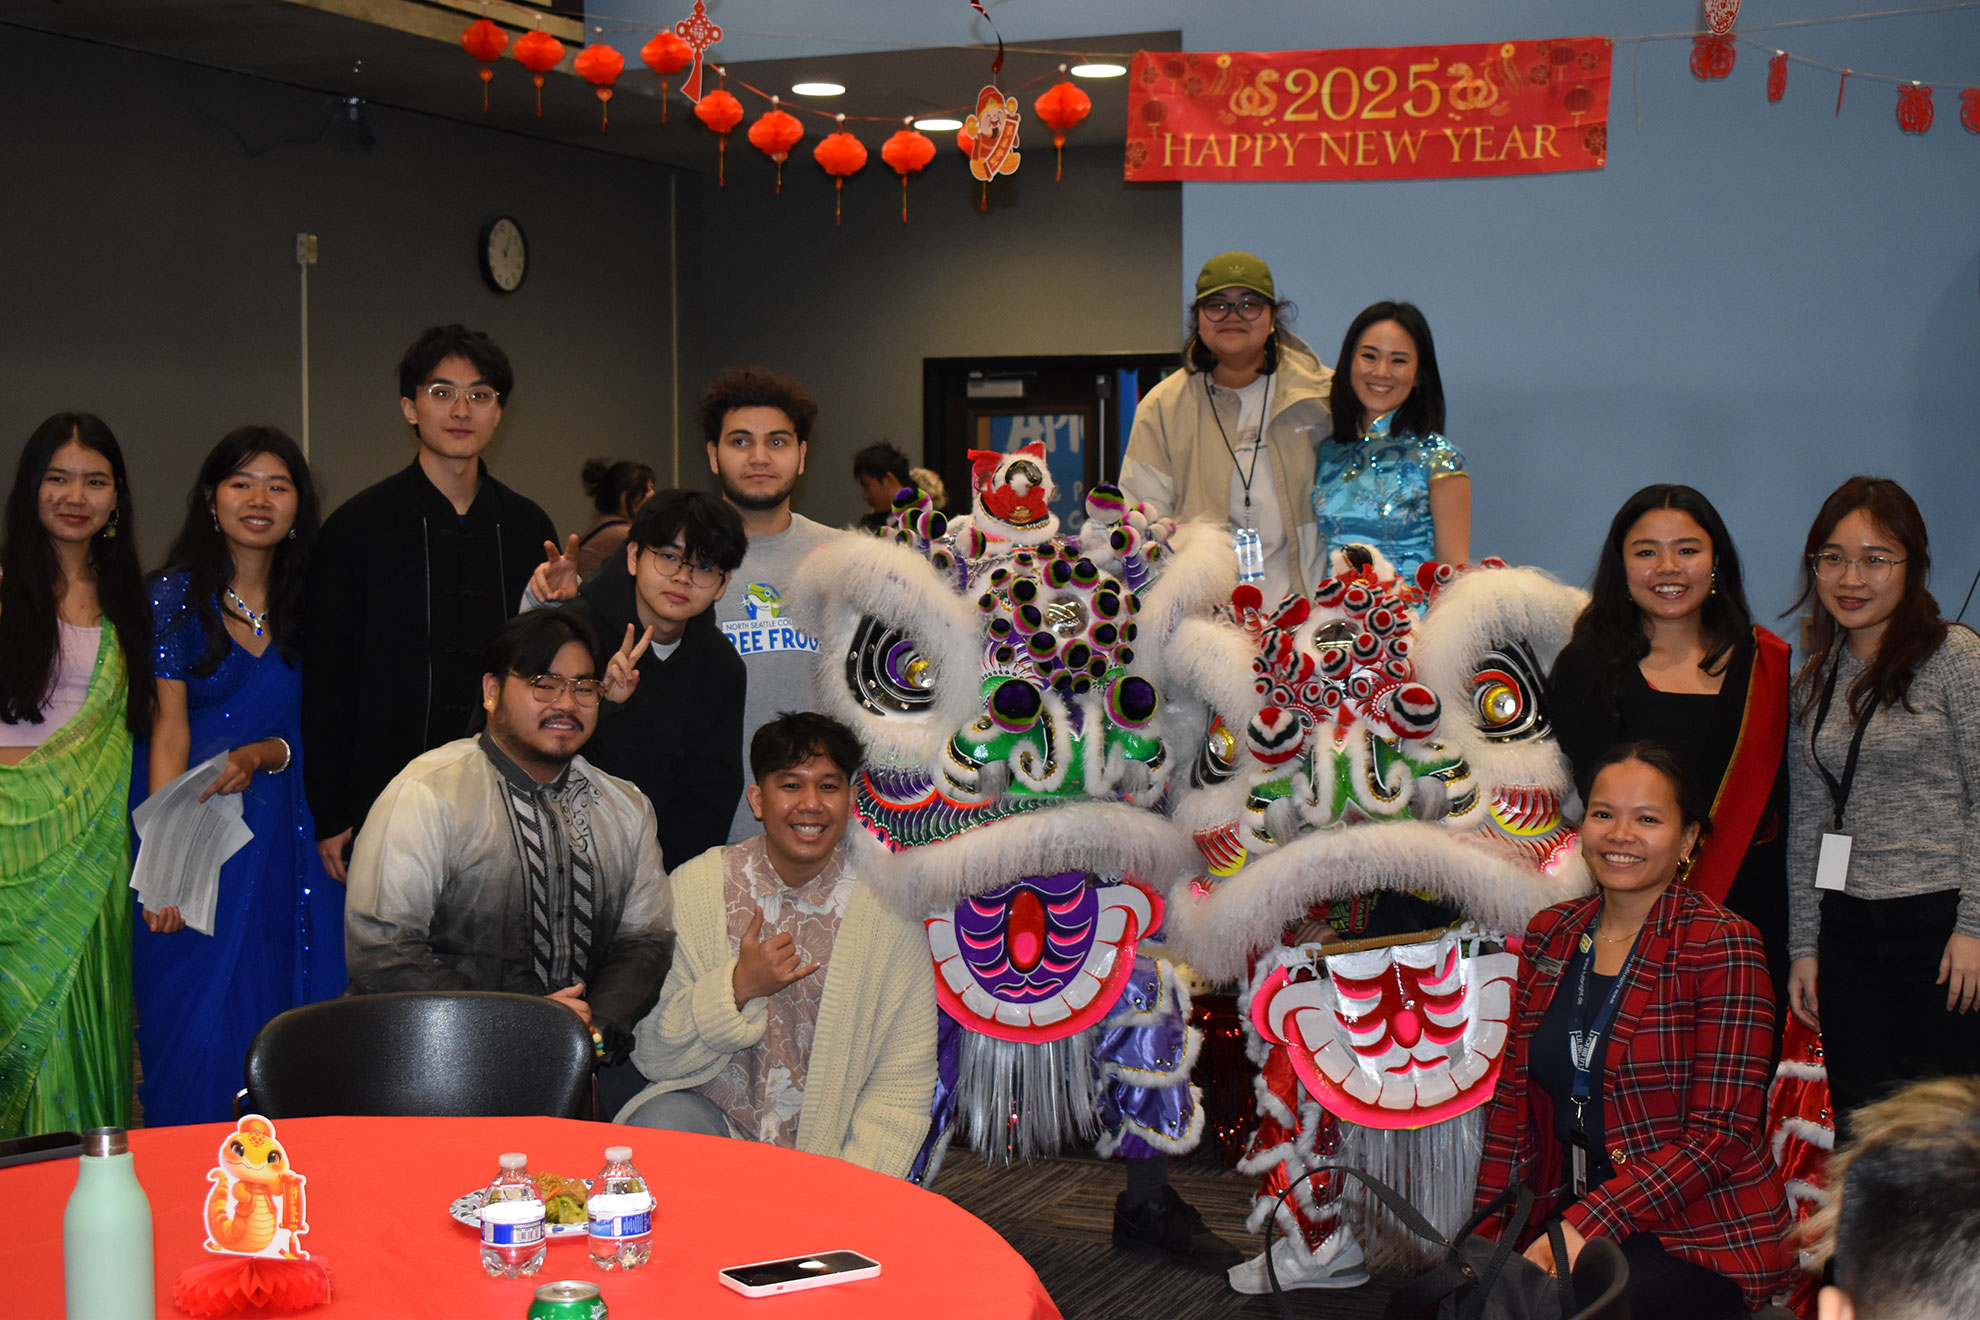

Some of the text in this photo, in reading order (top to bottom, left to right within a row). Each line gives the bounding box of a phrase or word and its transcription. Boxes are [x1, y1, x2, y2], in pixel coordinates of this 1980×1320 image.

[1283, 58, 1442, 121] 2025
[1162, 124, 1561, 167] HAPPY NEW YEAR
[1006, 415, 1084, 453] API
[751, 620, 775, 629] SEATTLE
